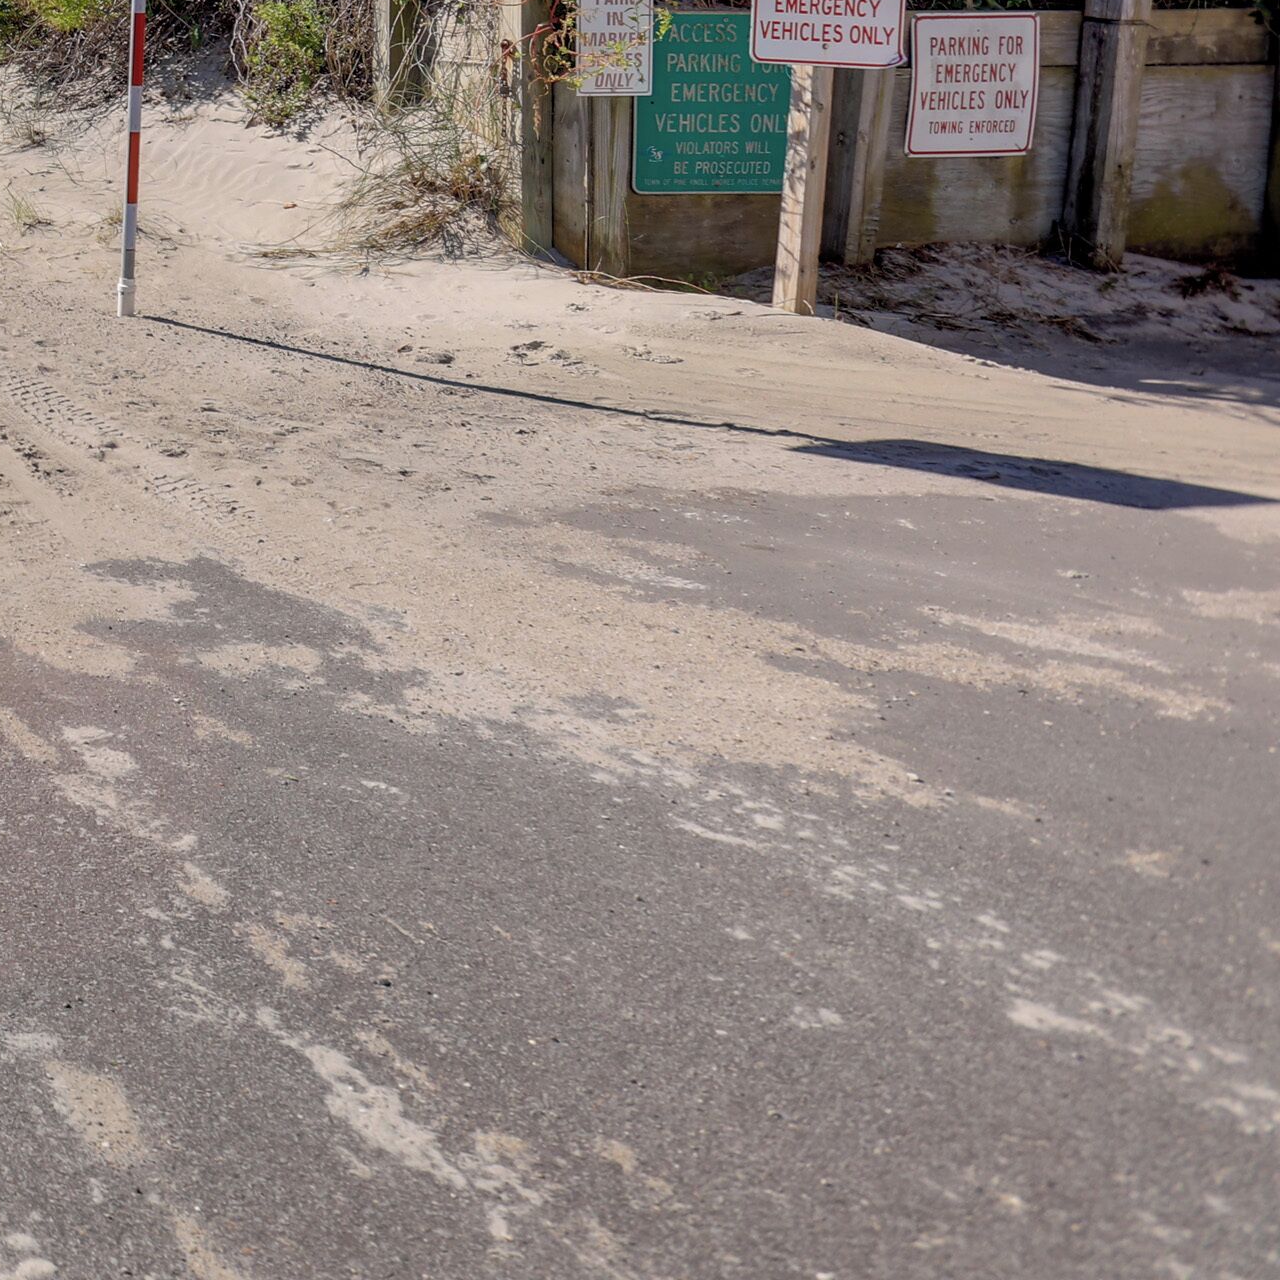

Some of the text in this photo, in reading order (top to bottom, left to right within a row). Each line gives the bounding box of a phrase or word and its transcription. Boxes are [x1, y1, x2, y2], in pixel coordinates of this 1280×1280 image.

[607, 12, 625, 26] IN
[583, 32, 646, 47] MARKE
[668, 23, 738, 43] ACCESS
[760, 20, 895, 46] VEHICLES ONLY
[930, 36, 1023, 56] PARKING FOR
[667, 53, 741, 73] PARKING
[936, 63, 1016, 83] EMERGENCY
[594, 72, 634, 88] ONLY
[671, 83, 779, 103] EMERGENCY
[921, 90, 1029, 111] VEHICLES ONLY
[655, 113, 788, 133] VEHICLES ONL
[929, 120, 1015, 134] TOWING ENFORCED
[676, 141, 772, 154] VIOLATORS WILL
[674, 161, 771, 175] BE PROSECUTED
